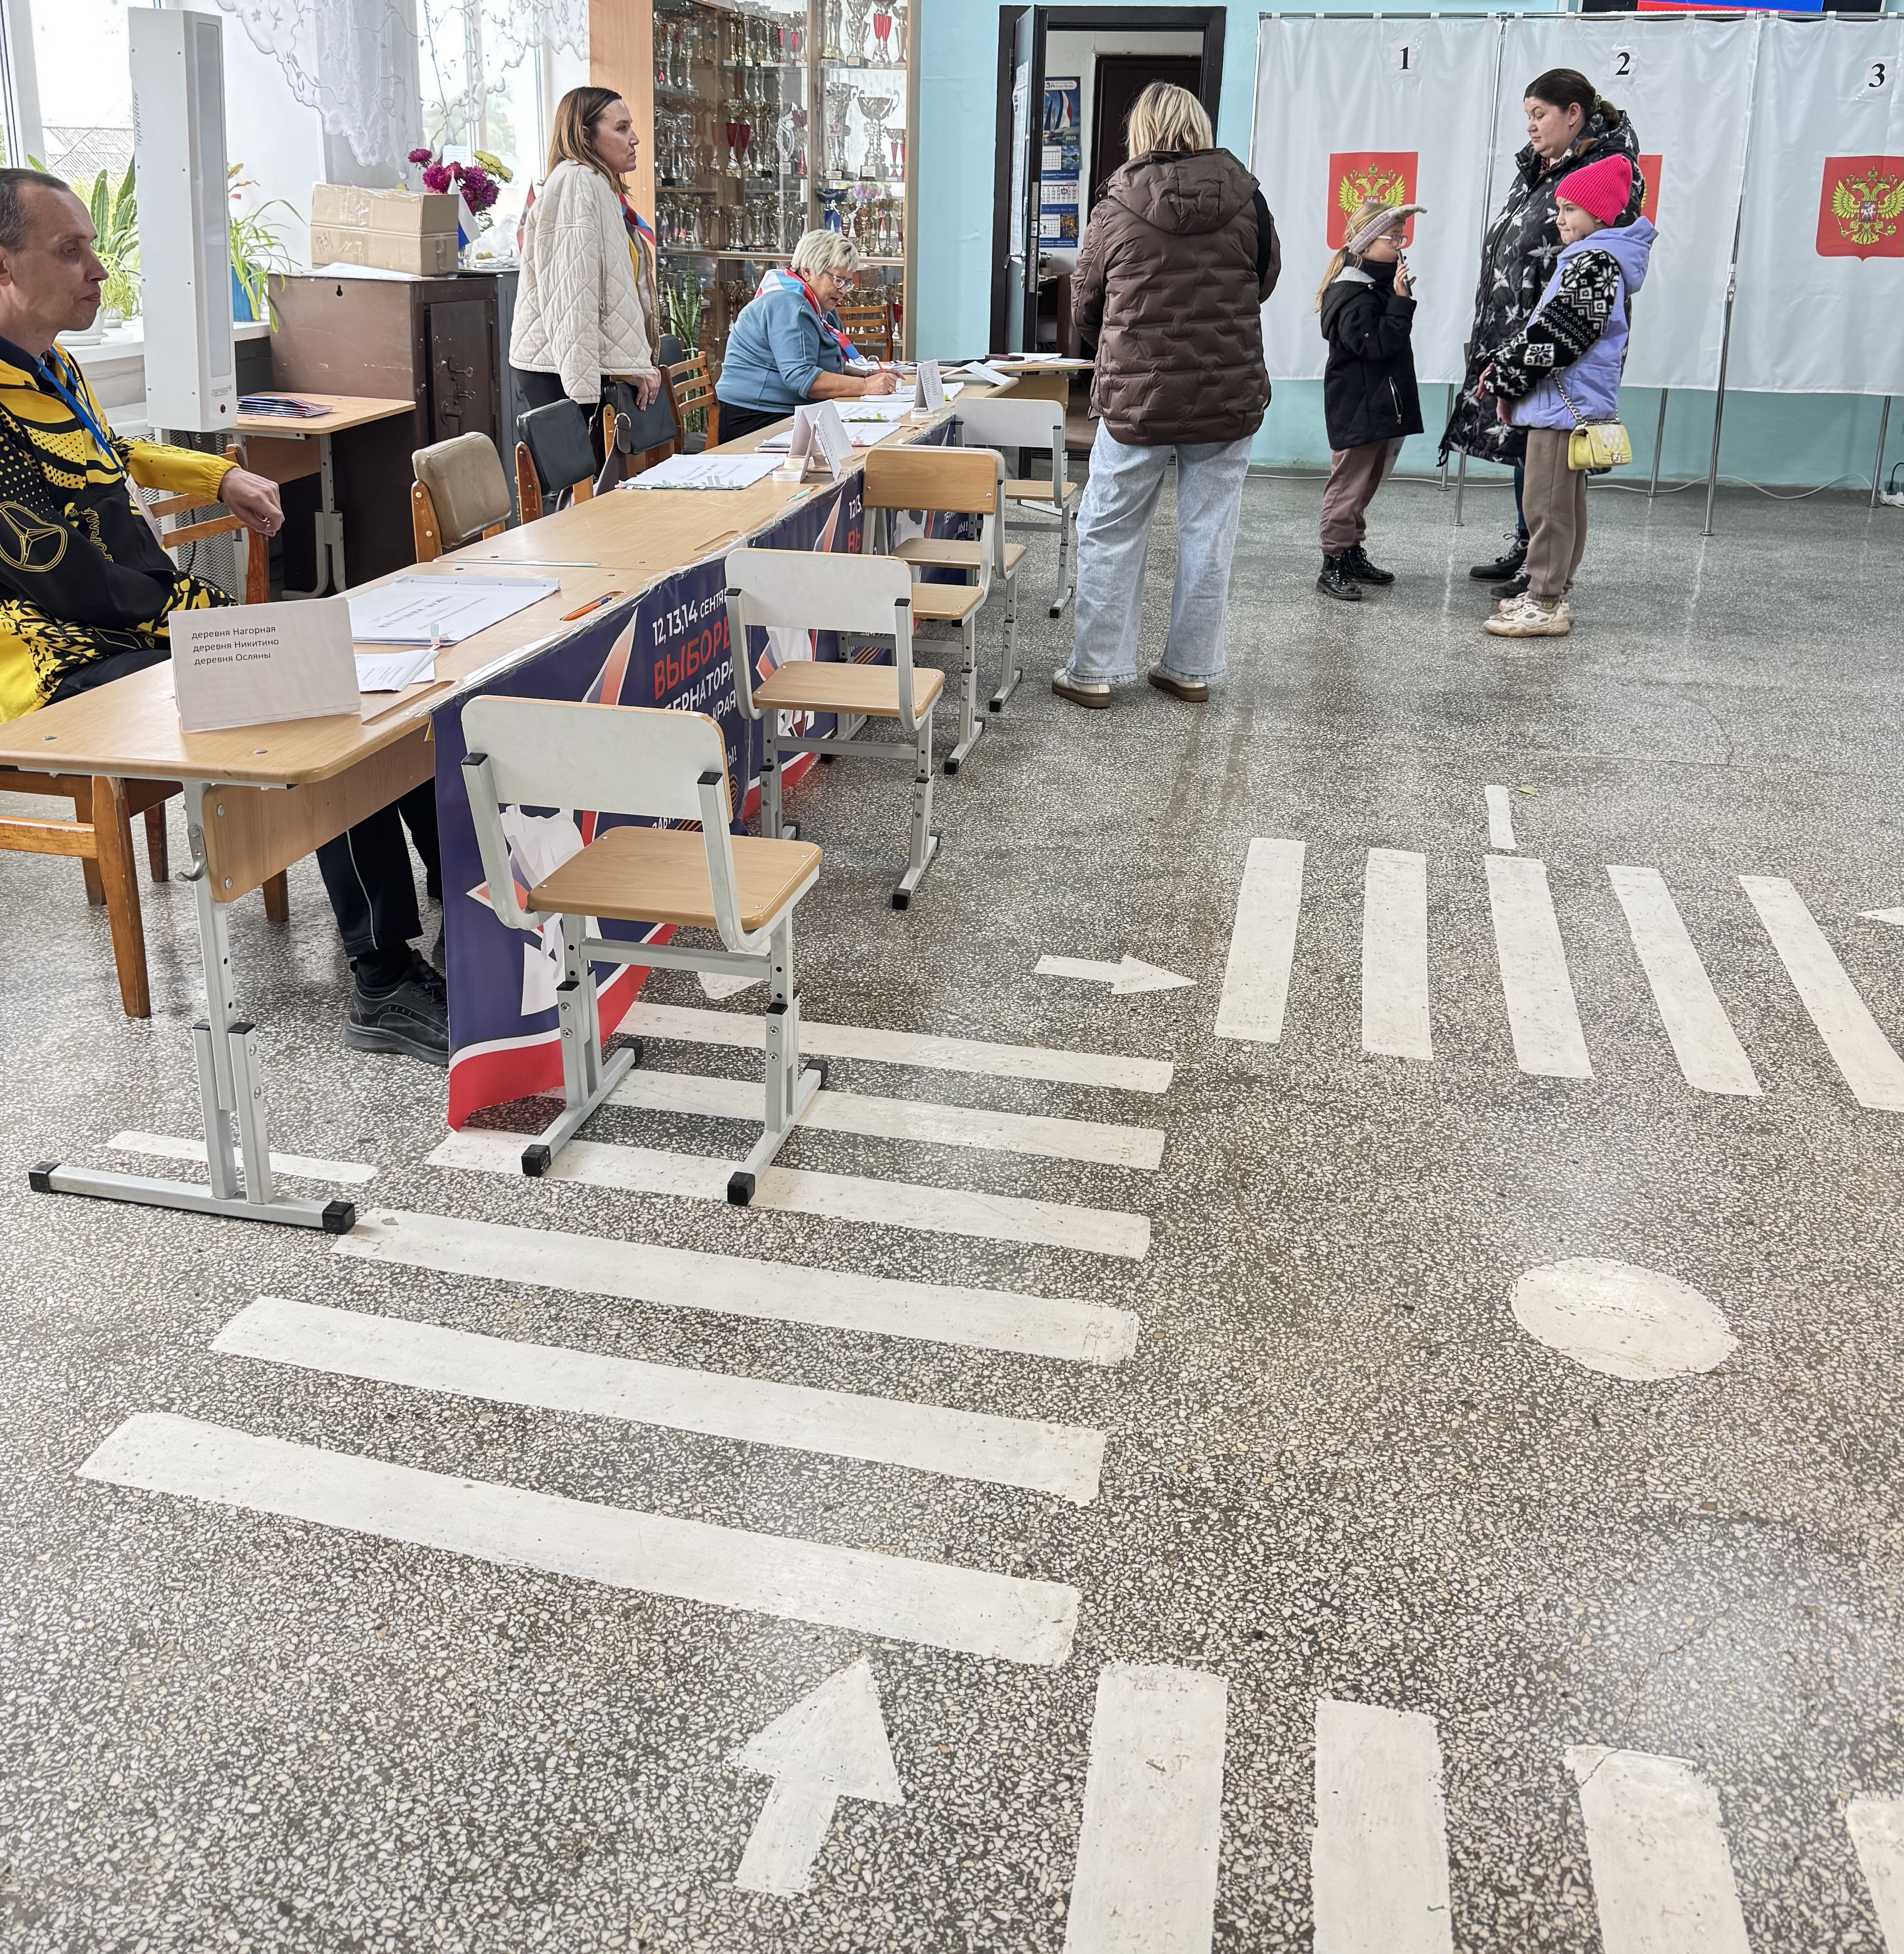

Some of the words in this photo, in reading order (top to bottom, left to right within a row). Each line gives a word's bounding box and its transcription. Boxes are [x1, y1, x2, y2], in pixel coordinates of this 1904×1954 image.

[1399, 46, 1411, 70] 1
[1615, 52, 1630, 75] 2
[1868, 63, 1885, 88] 3
[192, 630, 230, 640] деревня
[233, 626, 276, 635] Нагорная
[193, 643, 232, 653] деревня
[234, 639, 279, 648] Никитино
[194, 656, 233, 666] деревня
[236, 653, 271, 661] Осляны
